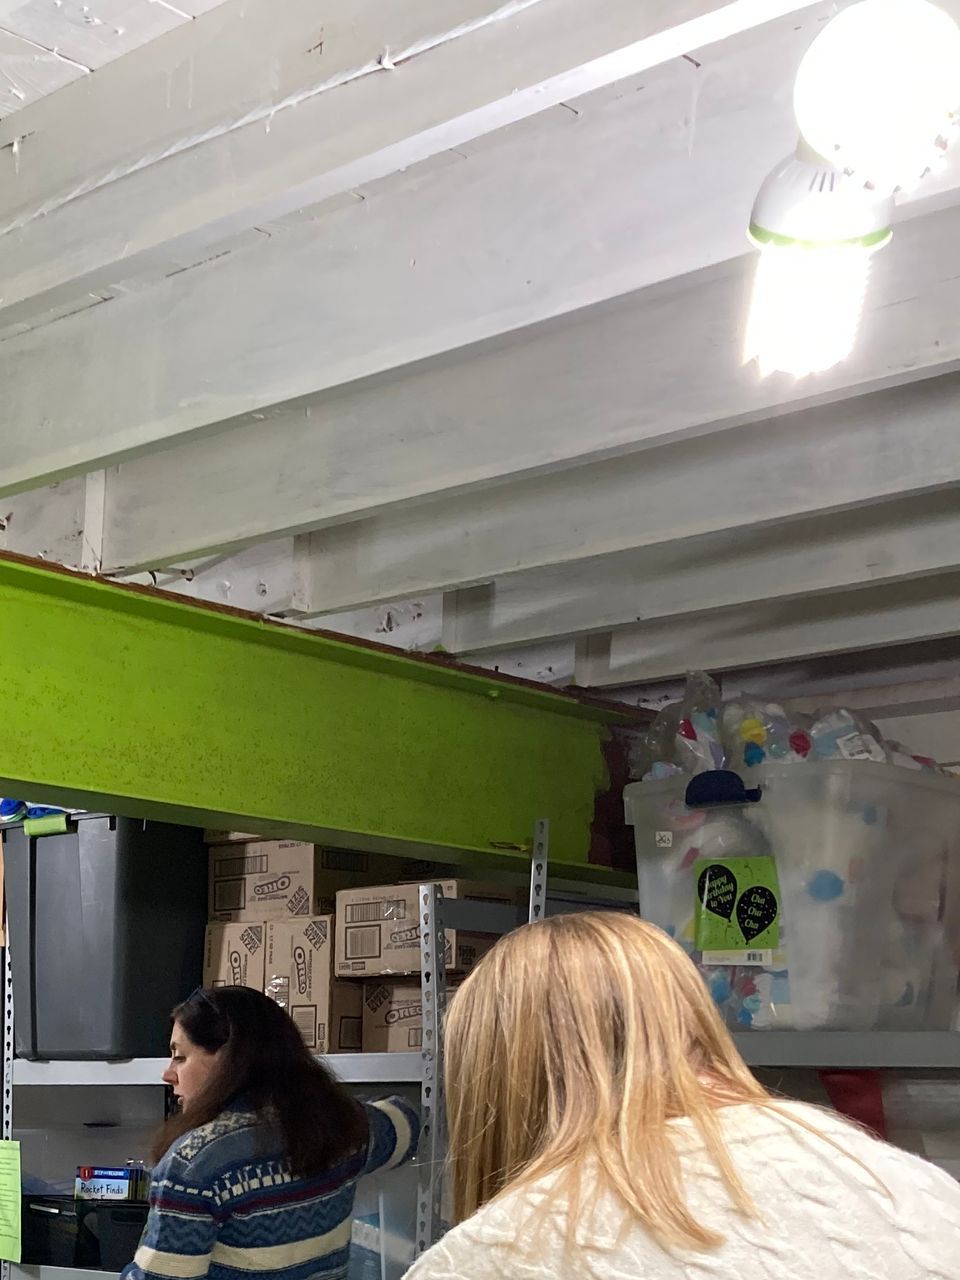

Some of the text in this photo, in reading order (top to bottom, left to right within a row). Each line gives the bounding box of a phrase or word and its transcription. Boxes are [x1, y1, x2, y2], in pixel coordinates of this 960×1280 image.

[253, 875, 291, 896] OREO
[294, 946, 307, 994] OREO
[81, 1182, 124, 1195] Rocket Finds
